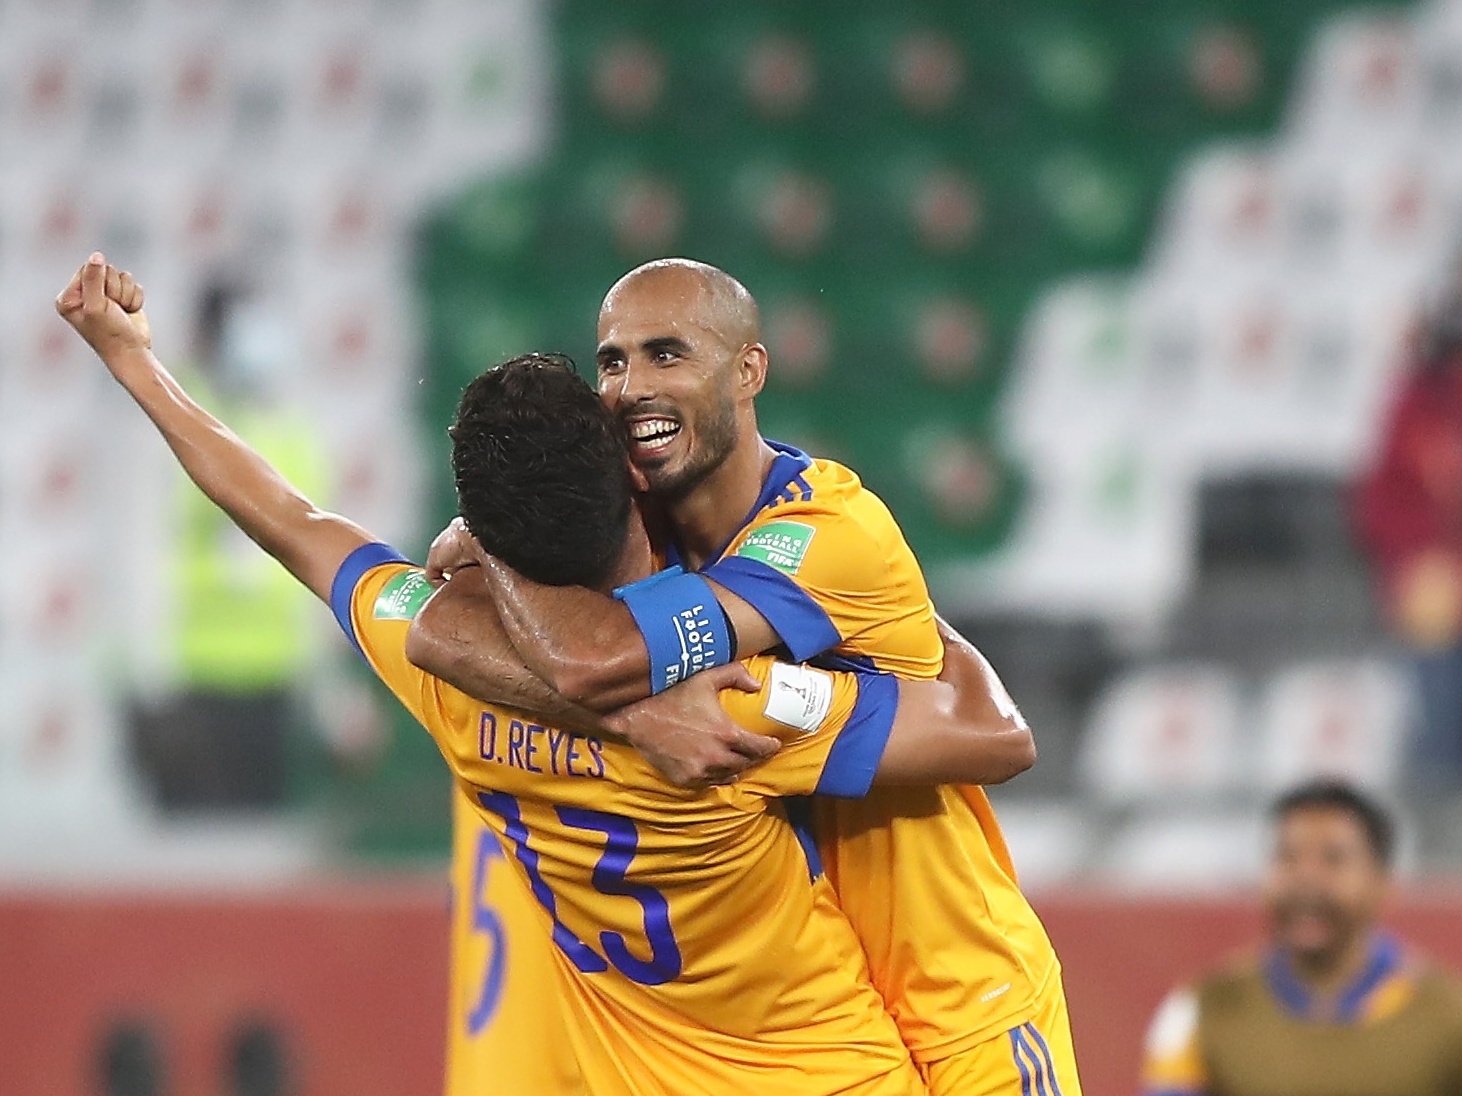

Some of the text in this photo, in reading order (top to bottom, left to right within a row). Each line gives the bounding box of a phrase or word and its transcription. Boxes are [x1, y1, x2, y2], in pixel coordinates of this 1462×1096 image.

[767, 552, 795, 566] FIFA
[478, 711, 606, 778] D.REYES
[477, 791, 684, 986] 13
